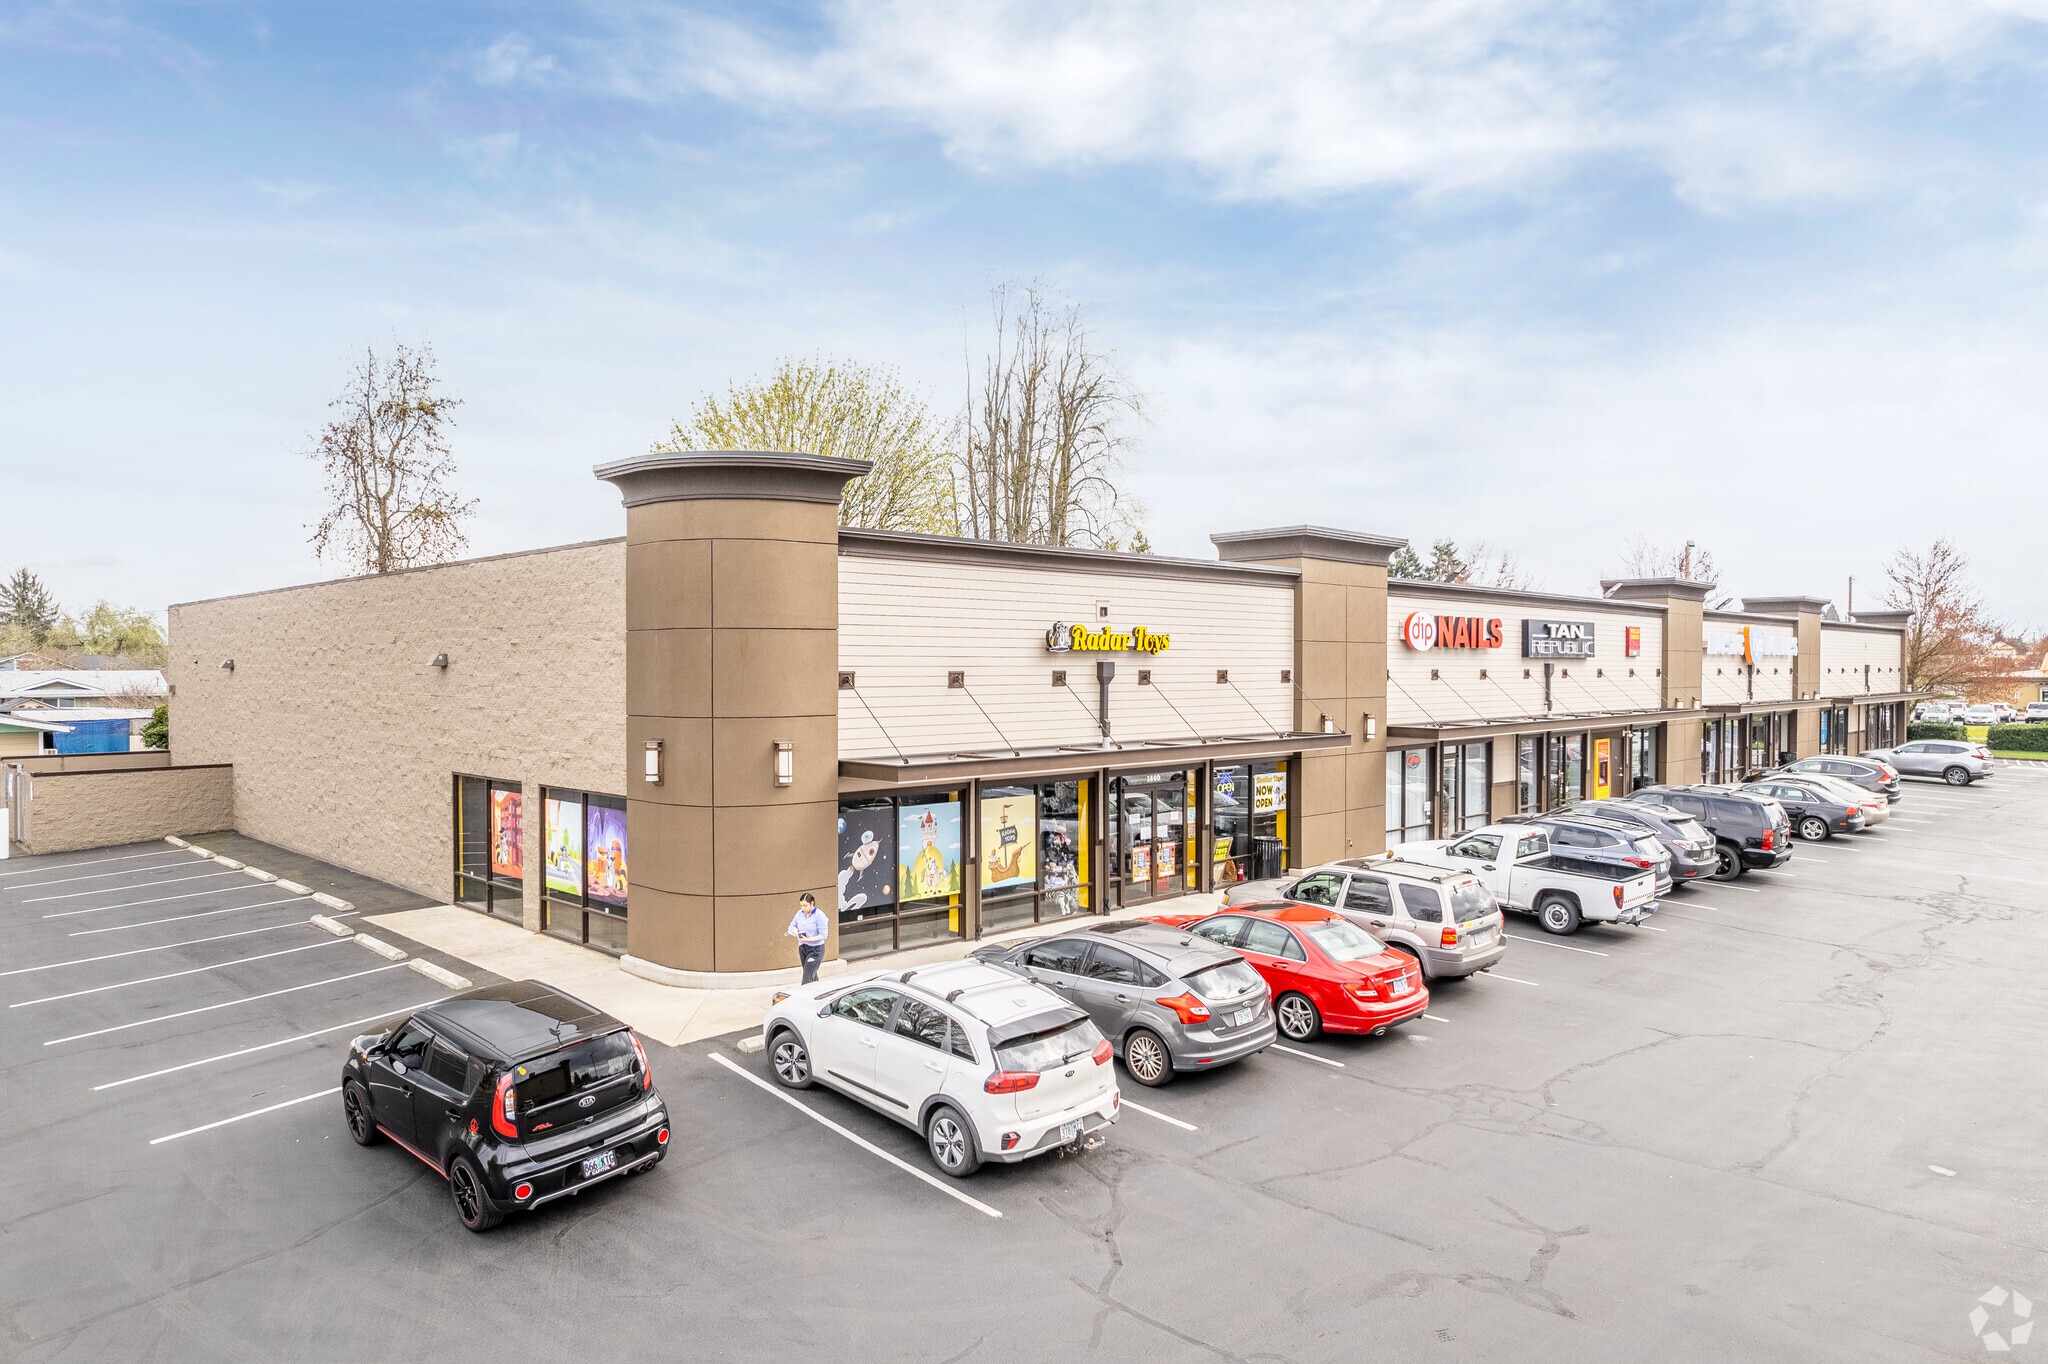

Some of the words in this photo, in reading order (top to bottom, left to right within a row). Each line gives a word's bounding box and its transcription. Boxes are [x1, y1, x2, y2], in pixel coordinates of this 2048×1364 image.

[1411, 617, 1432, 645] dip
[1436, 615, 1503, 648] NAILS
[1546, 623, 1585, 639] TAN
[1070, 624, 1131, 651] Radar
[1133, 626, 1170, 655] Toys
[1531, 639, 1595, 656] REPUBLIC
[1216, 782, 1235, 793] OPEN
[1255, 785, 1274, 796] NOW
[1255, 797, 1273, 808] OPEN
